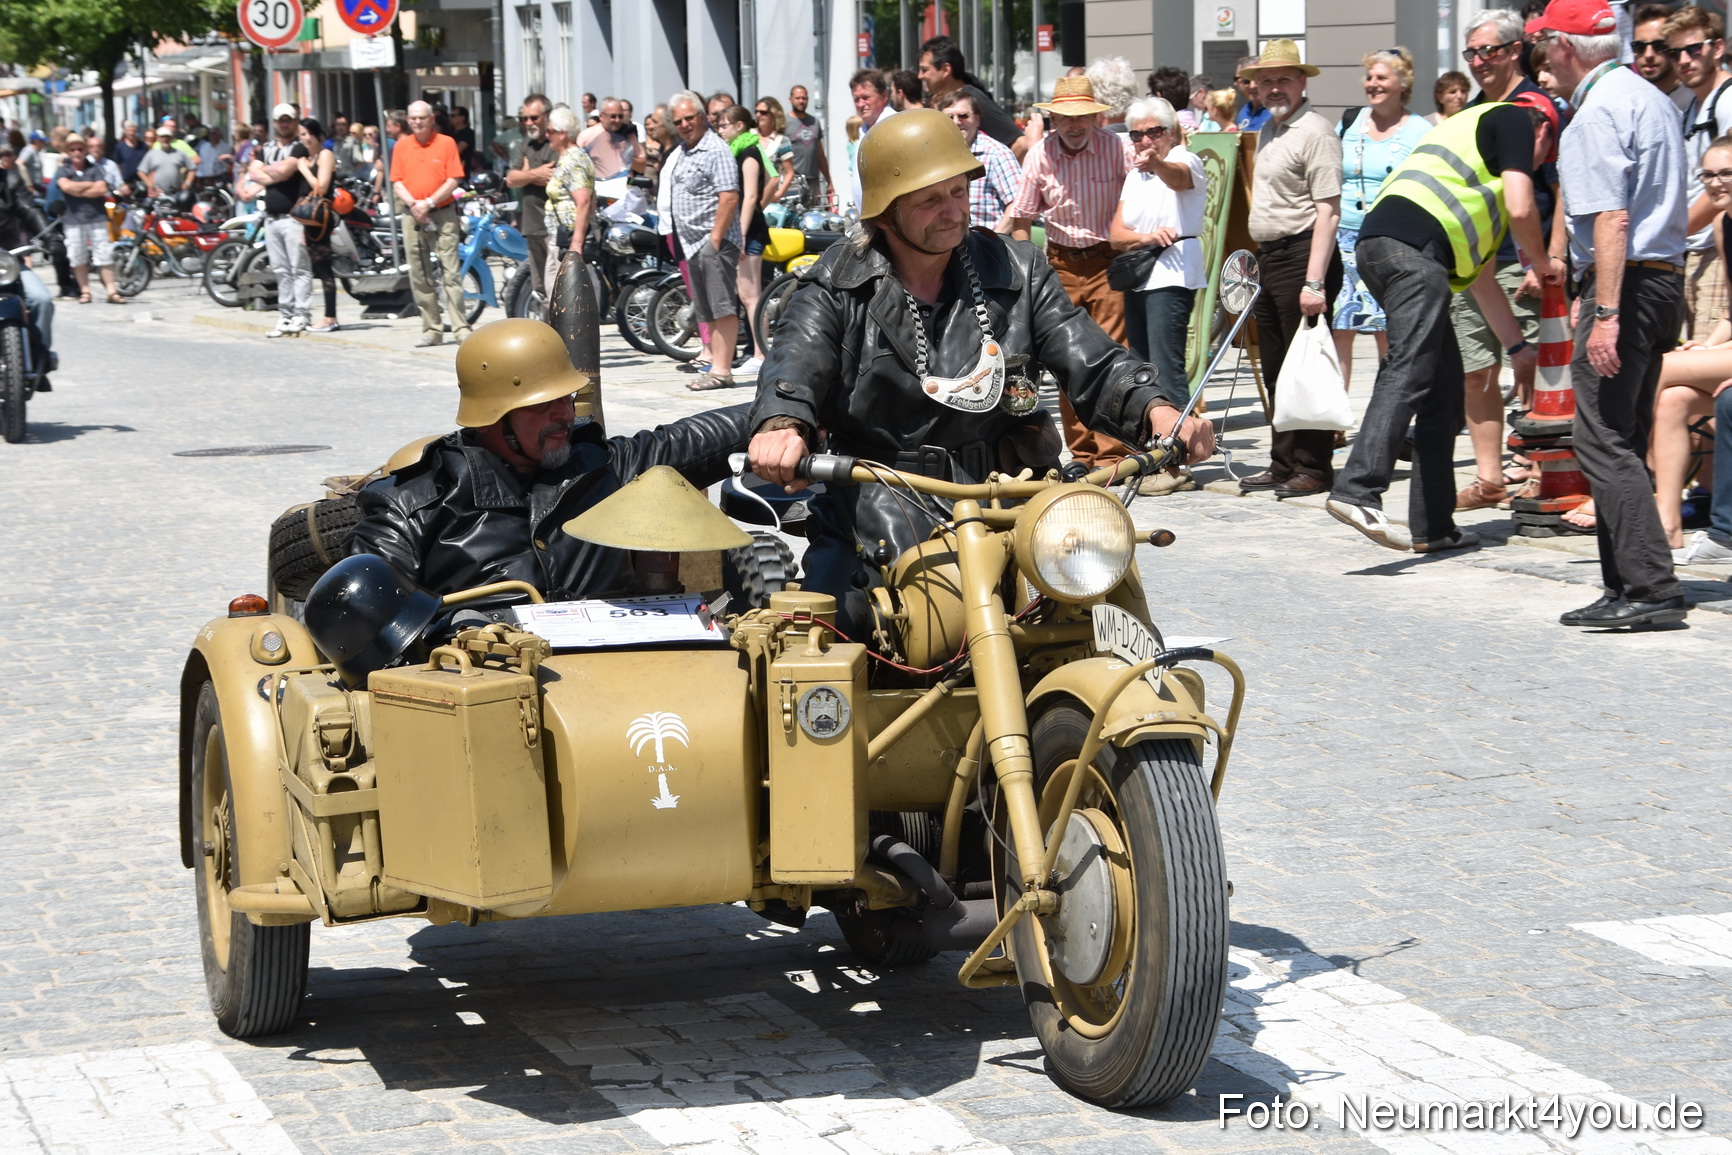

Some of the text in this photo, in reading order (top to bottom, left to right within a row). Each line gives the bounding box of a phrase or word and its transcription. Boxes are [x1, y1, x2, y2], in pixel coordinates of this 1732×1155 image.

[253, 0, 289, 29] 30
[609, 608, 670, 618] 563
[648, 764, 677, 773] D.A.K.
